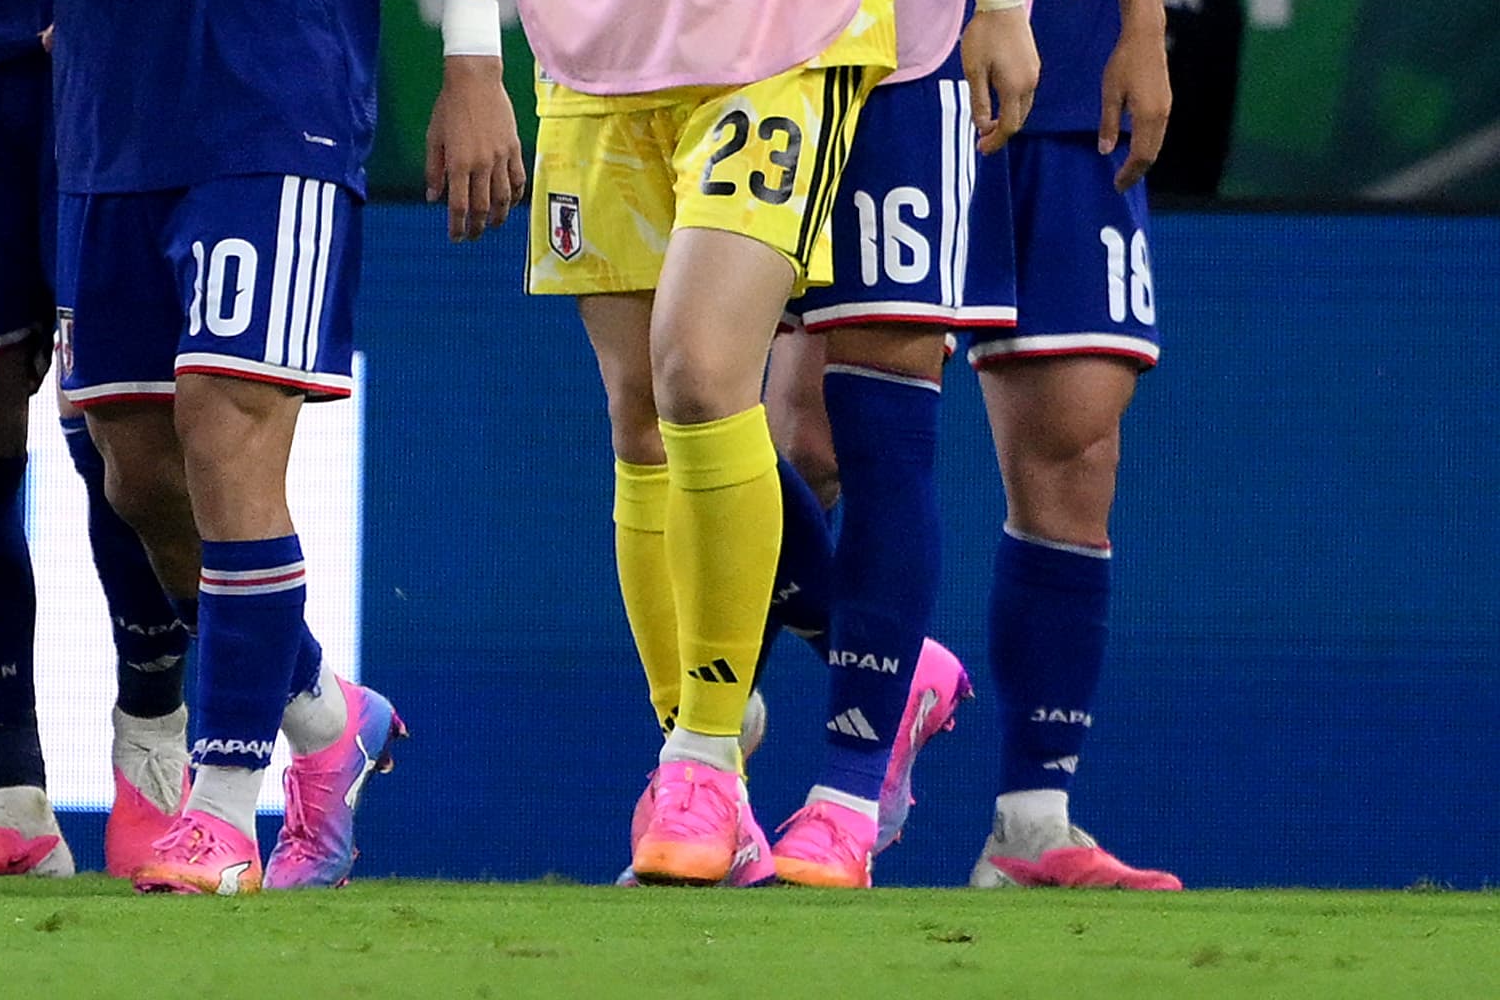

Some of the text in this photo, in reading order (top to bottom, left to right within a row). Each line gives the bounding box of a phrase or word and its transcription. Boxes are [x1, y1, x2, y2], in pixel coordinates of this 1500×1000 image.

[702, 110, 802, 204] 23
[855, 187, 931, 285] 16
[1101, 227, 1156, 325] 18
[190, 239, 258, 337] 10
